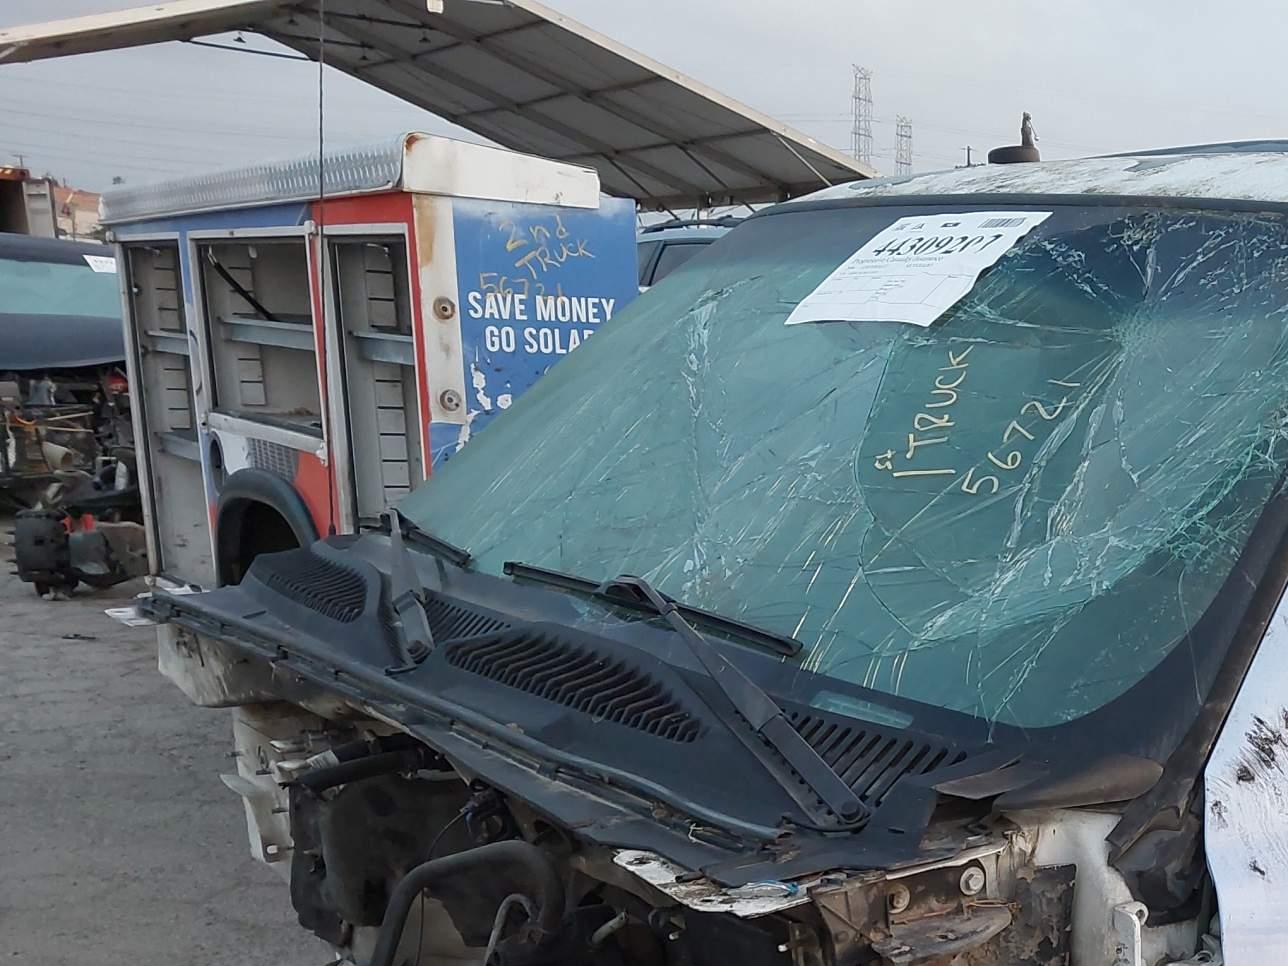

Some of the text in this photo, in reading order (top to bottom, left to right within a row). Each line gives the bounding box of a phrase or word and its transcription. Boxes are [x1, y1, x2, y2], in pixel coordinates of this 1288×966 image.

[498, 215, 569, 252] 2nd
[872, 233, 1004, 257] 44309207
[516, 240, 595, 280] TRUCK
[469, 292, 615, 323] SAVE MONEY
[486, 326, 516, 354] GO
[906, 345, 975, 459] TRUCK
[961, 378, 1081, 494] 56721
